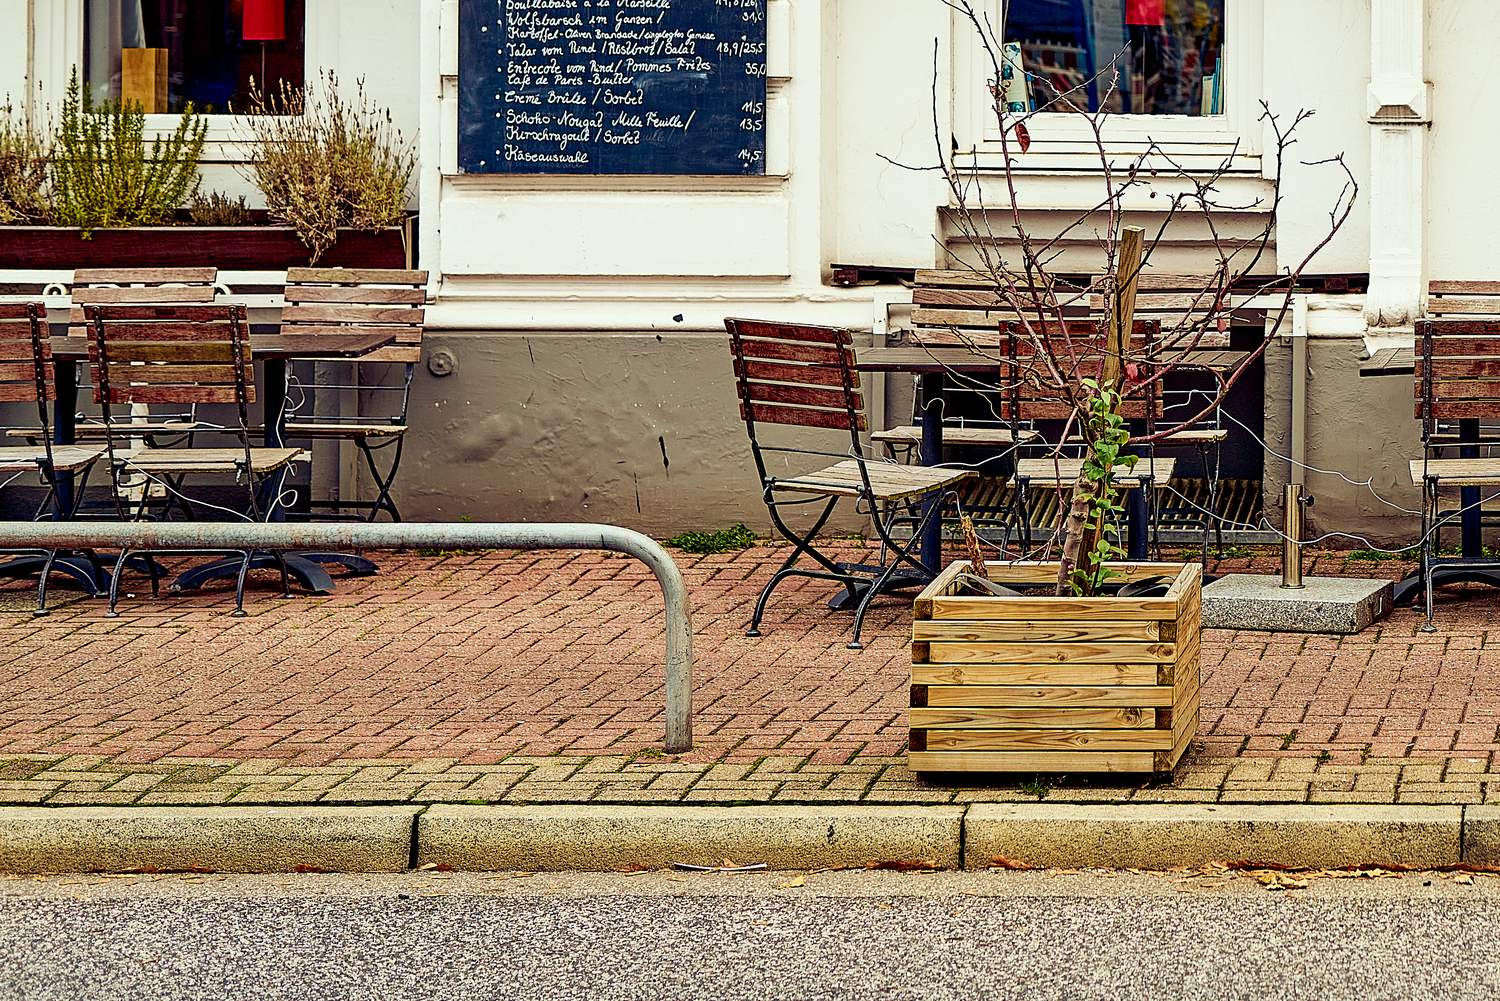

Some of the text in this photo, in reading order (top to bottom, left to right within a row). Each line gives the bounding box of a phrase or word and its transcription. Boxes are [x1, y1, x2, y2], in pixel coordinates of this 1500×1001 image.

[584, 0, 591, 8] a
[506, 11, 583, 30] Wolfsbarsch
[589, 16, 607, 24] im
[616, 10, 653, 32] Ganzen
[742, 11, 764, 23] 31,0
[506, 42, 537, 57] Tatar
[542, 47, 563, 56] vom
[569, 41, 596, 54] Rind
[716, 41, 765, 57] 18,9/25,5
[507, 58, 561, 74] Entrecote
[566, 64, 585, 73] vom
[627, 58, 672, 72] Pommes
[677, 56, 711, 71] Frites
[745, 62, 766, 78] 35,0
[535, 75, 549, 85] de
[554, 74, 583, 85] Paris
[603, 88, 643, 105] Sorbet
[741, 99, 763, 114] 11,5
[611, 110, 643, 127] Mille
[739, 118, 763, 131] 13,5
[603, 130, 640, 145] Sorbet
[504, 144, 589, 164] Käseauswahl
[737, 149, 762, 162] 14,5
